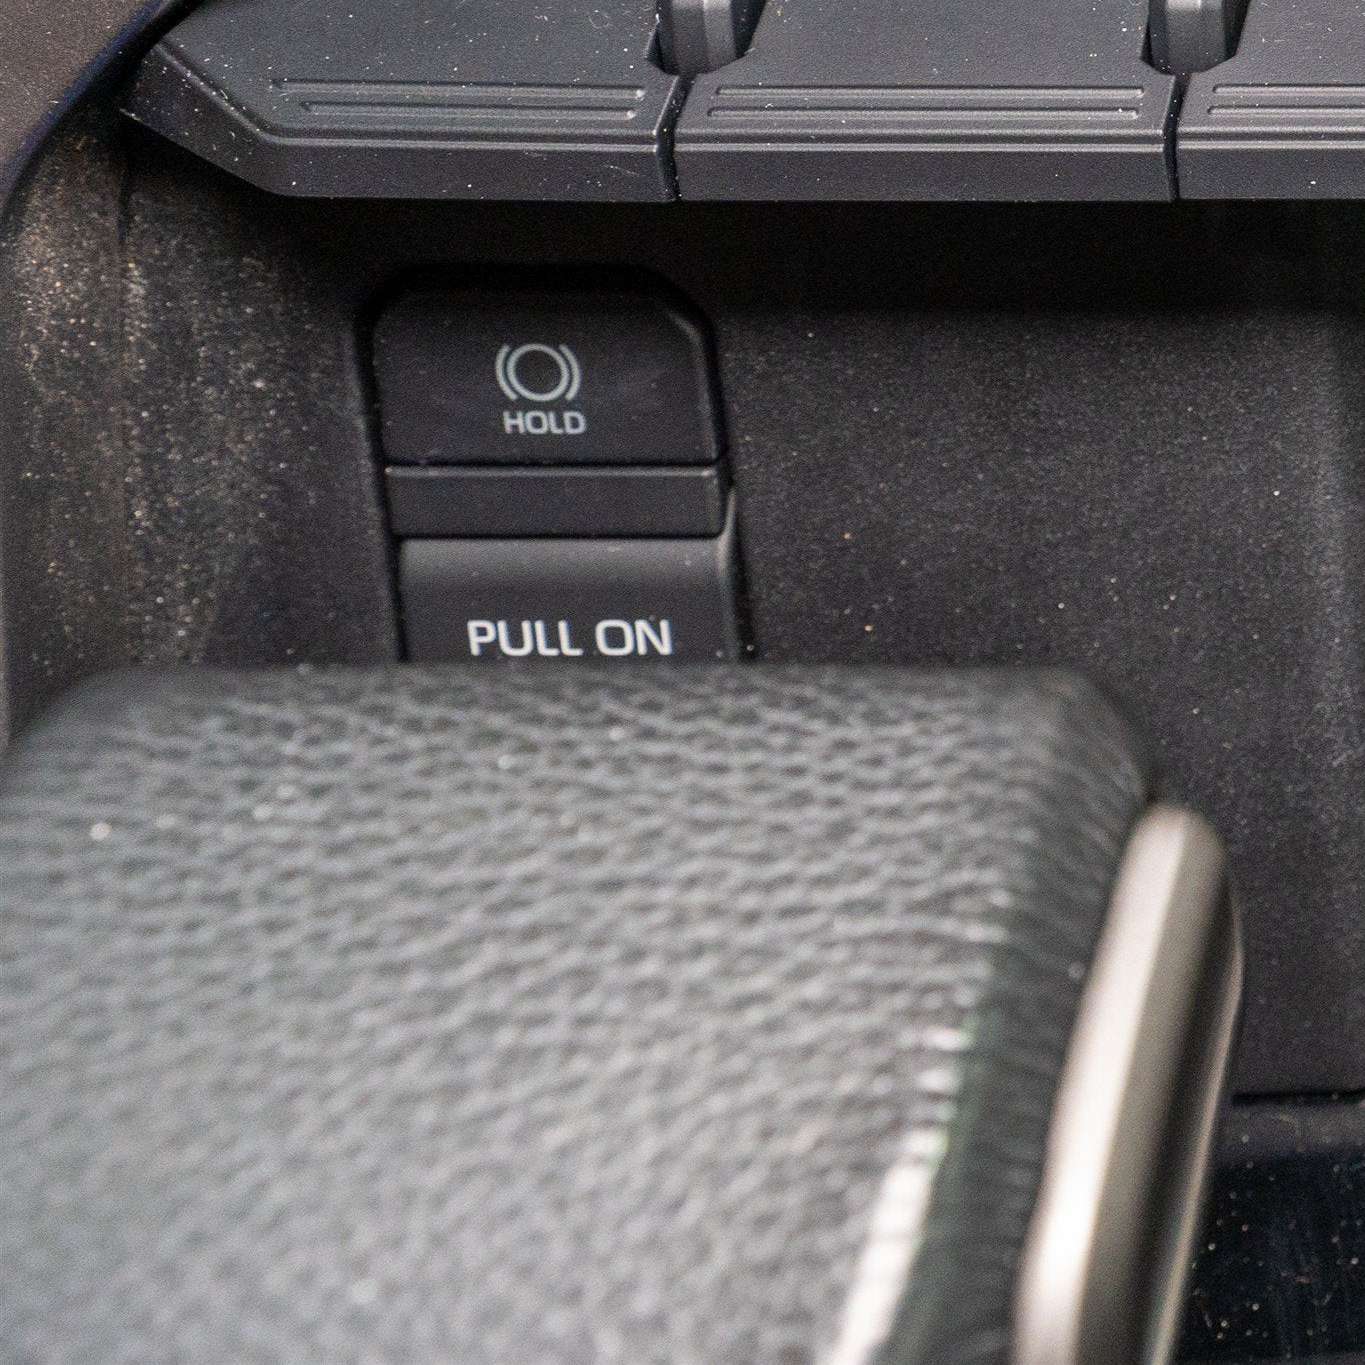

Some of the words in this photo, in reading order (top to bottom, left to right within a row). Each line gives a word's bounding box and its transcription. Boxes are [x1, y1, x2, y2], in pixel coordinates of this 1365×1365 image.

[503, 410, 587, 435] HOLD
[467, 620, 583, 657] PULL
[595, 619, 673, 657] ON
